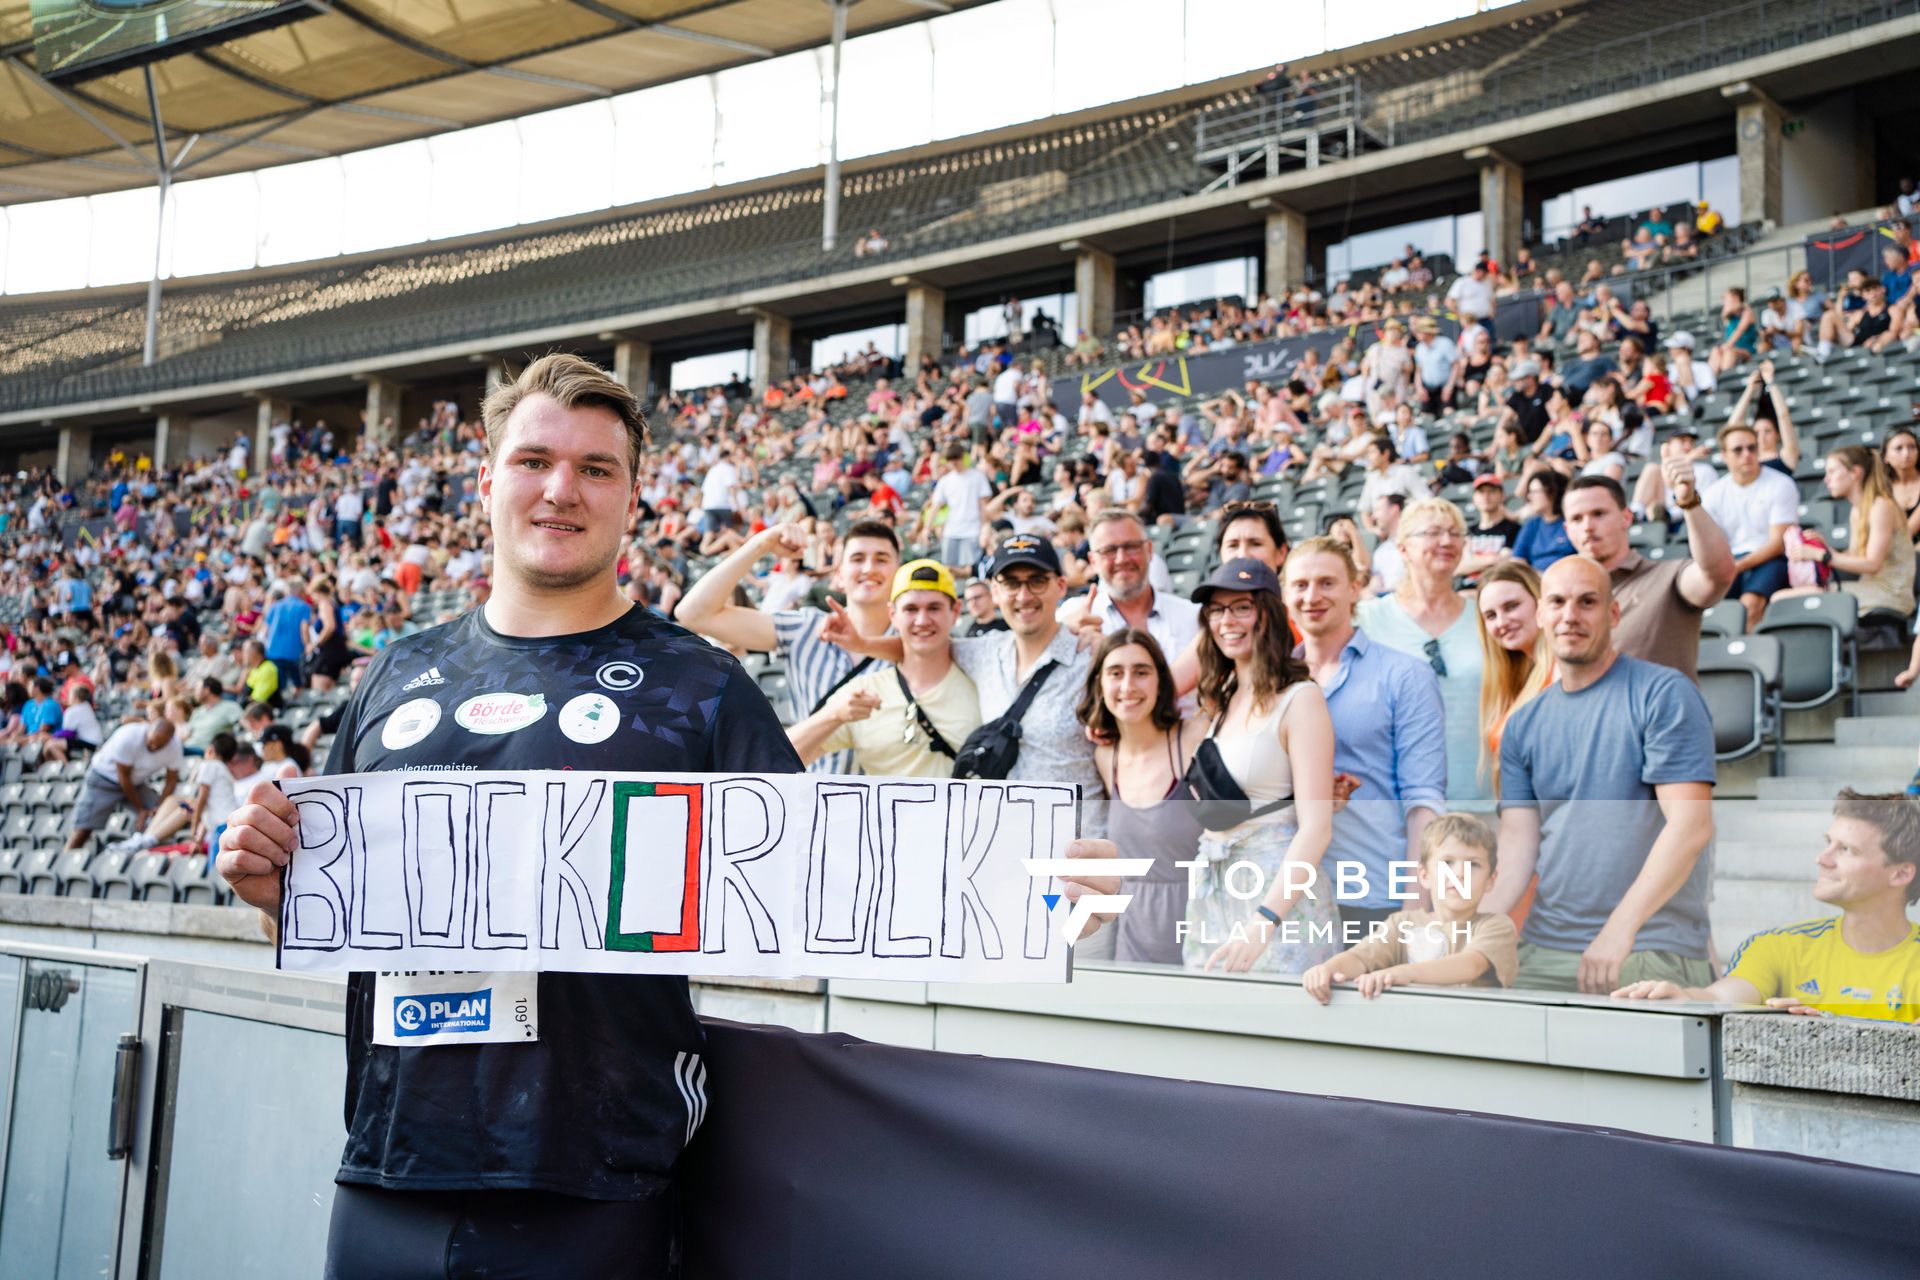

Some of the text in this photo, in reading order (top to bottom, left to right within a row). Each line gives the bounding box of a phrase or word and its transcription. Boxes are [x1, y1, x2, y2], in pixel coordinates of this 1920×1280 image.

[402, 677, 446, 691] adidas
[469, 700, 524, 717] Börde
[430, 998, 487, 1019] PLAN
[431, 1019, 486, 1029] INTERNATIONAL
